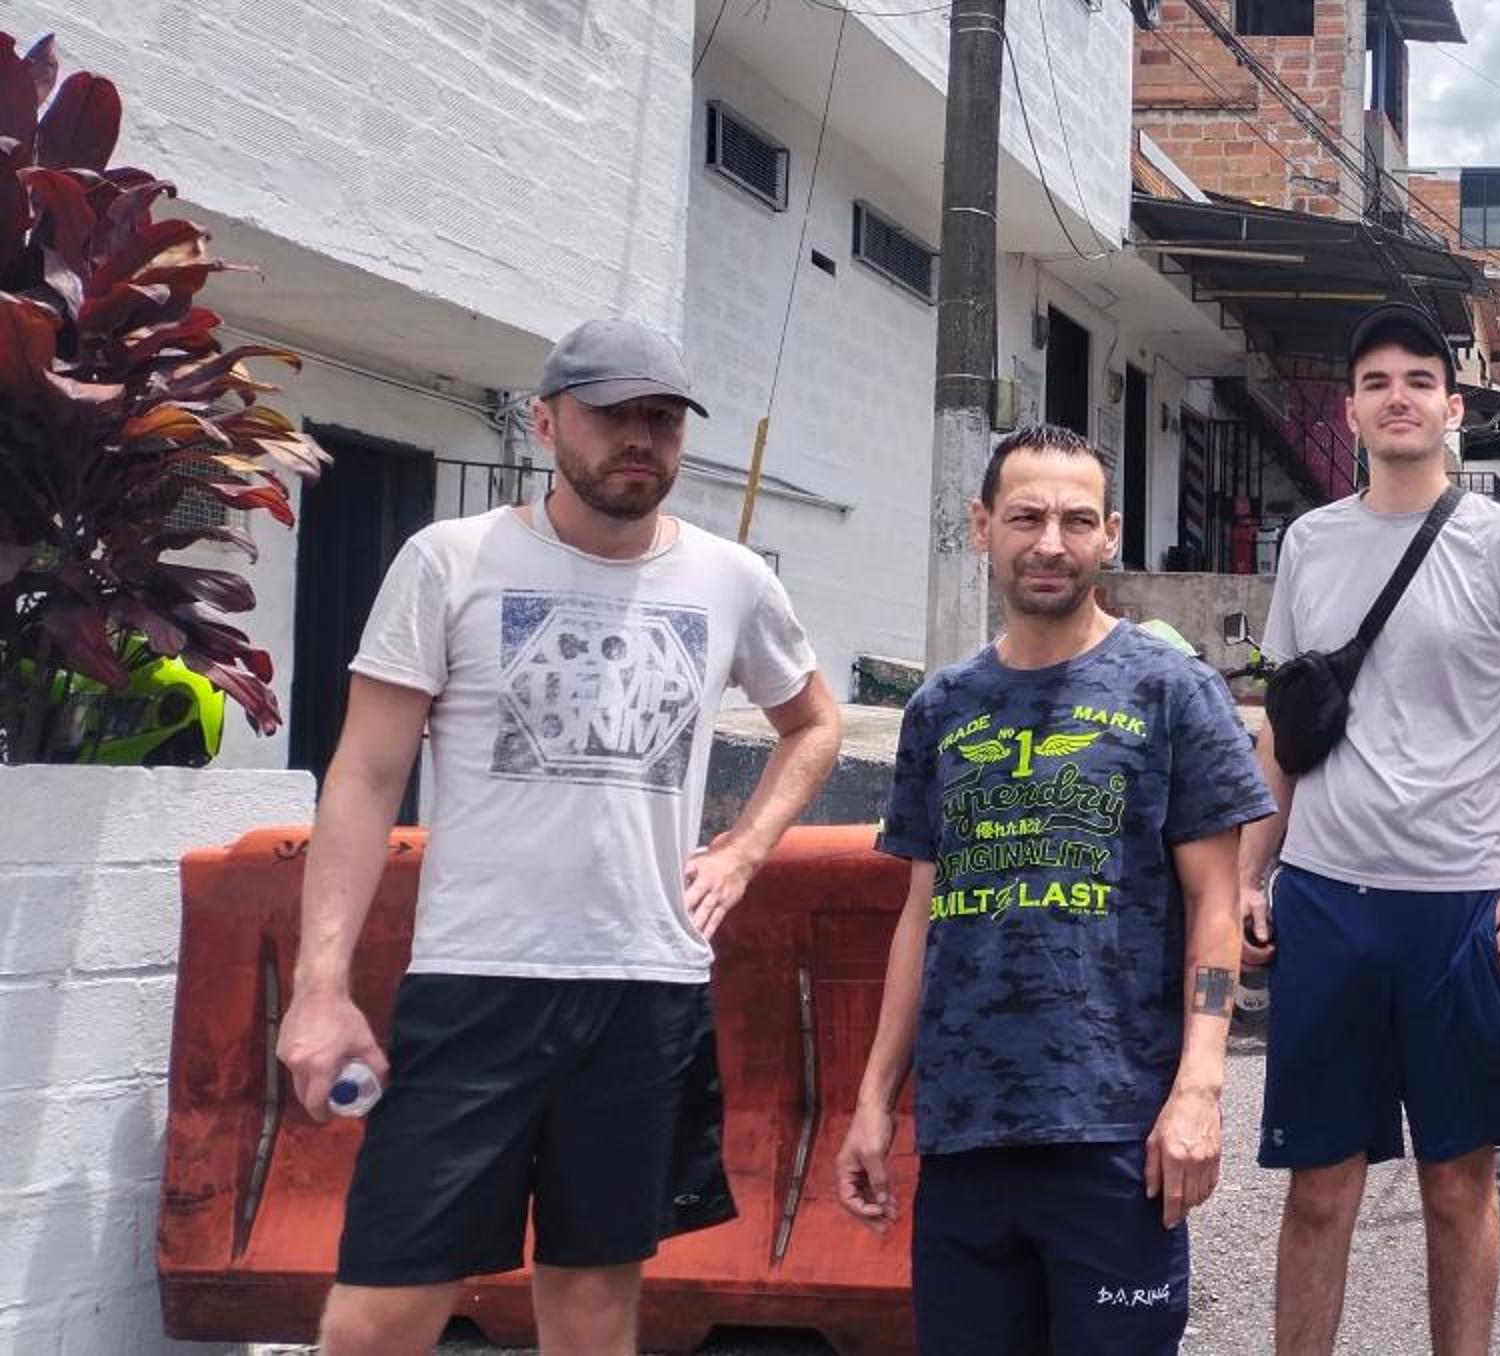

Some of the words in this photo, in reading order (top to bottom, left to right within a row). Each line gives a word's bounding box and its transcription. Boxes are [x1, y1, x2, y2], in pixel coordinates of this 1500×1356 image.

[938, 713, 991, 755] TRADE
[1012, 730, 1034, 777] 1
[1019, 880, 1112, 909] LAST
